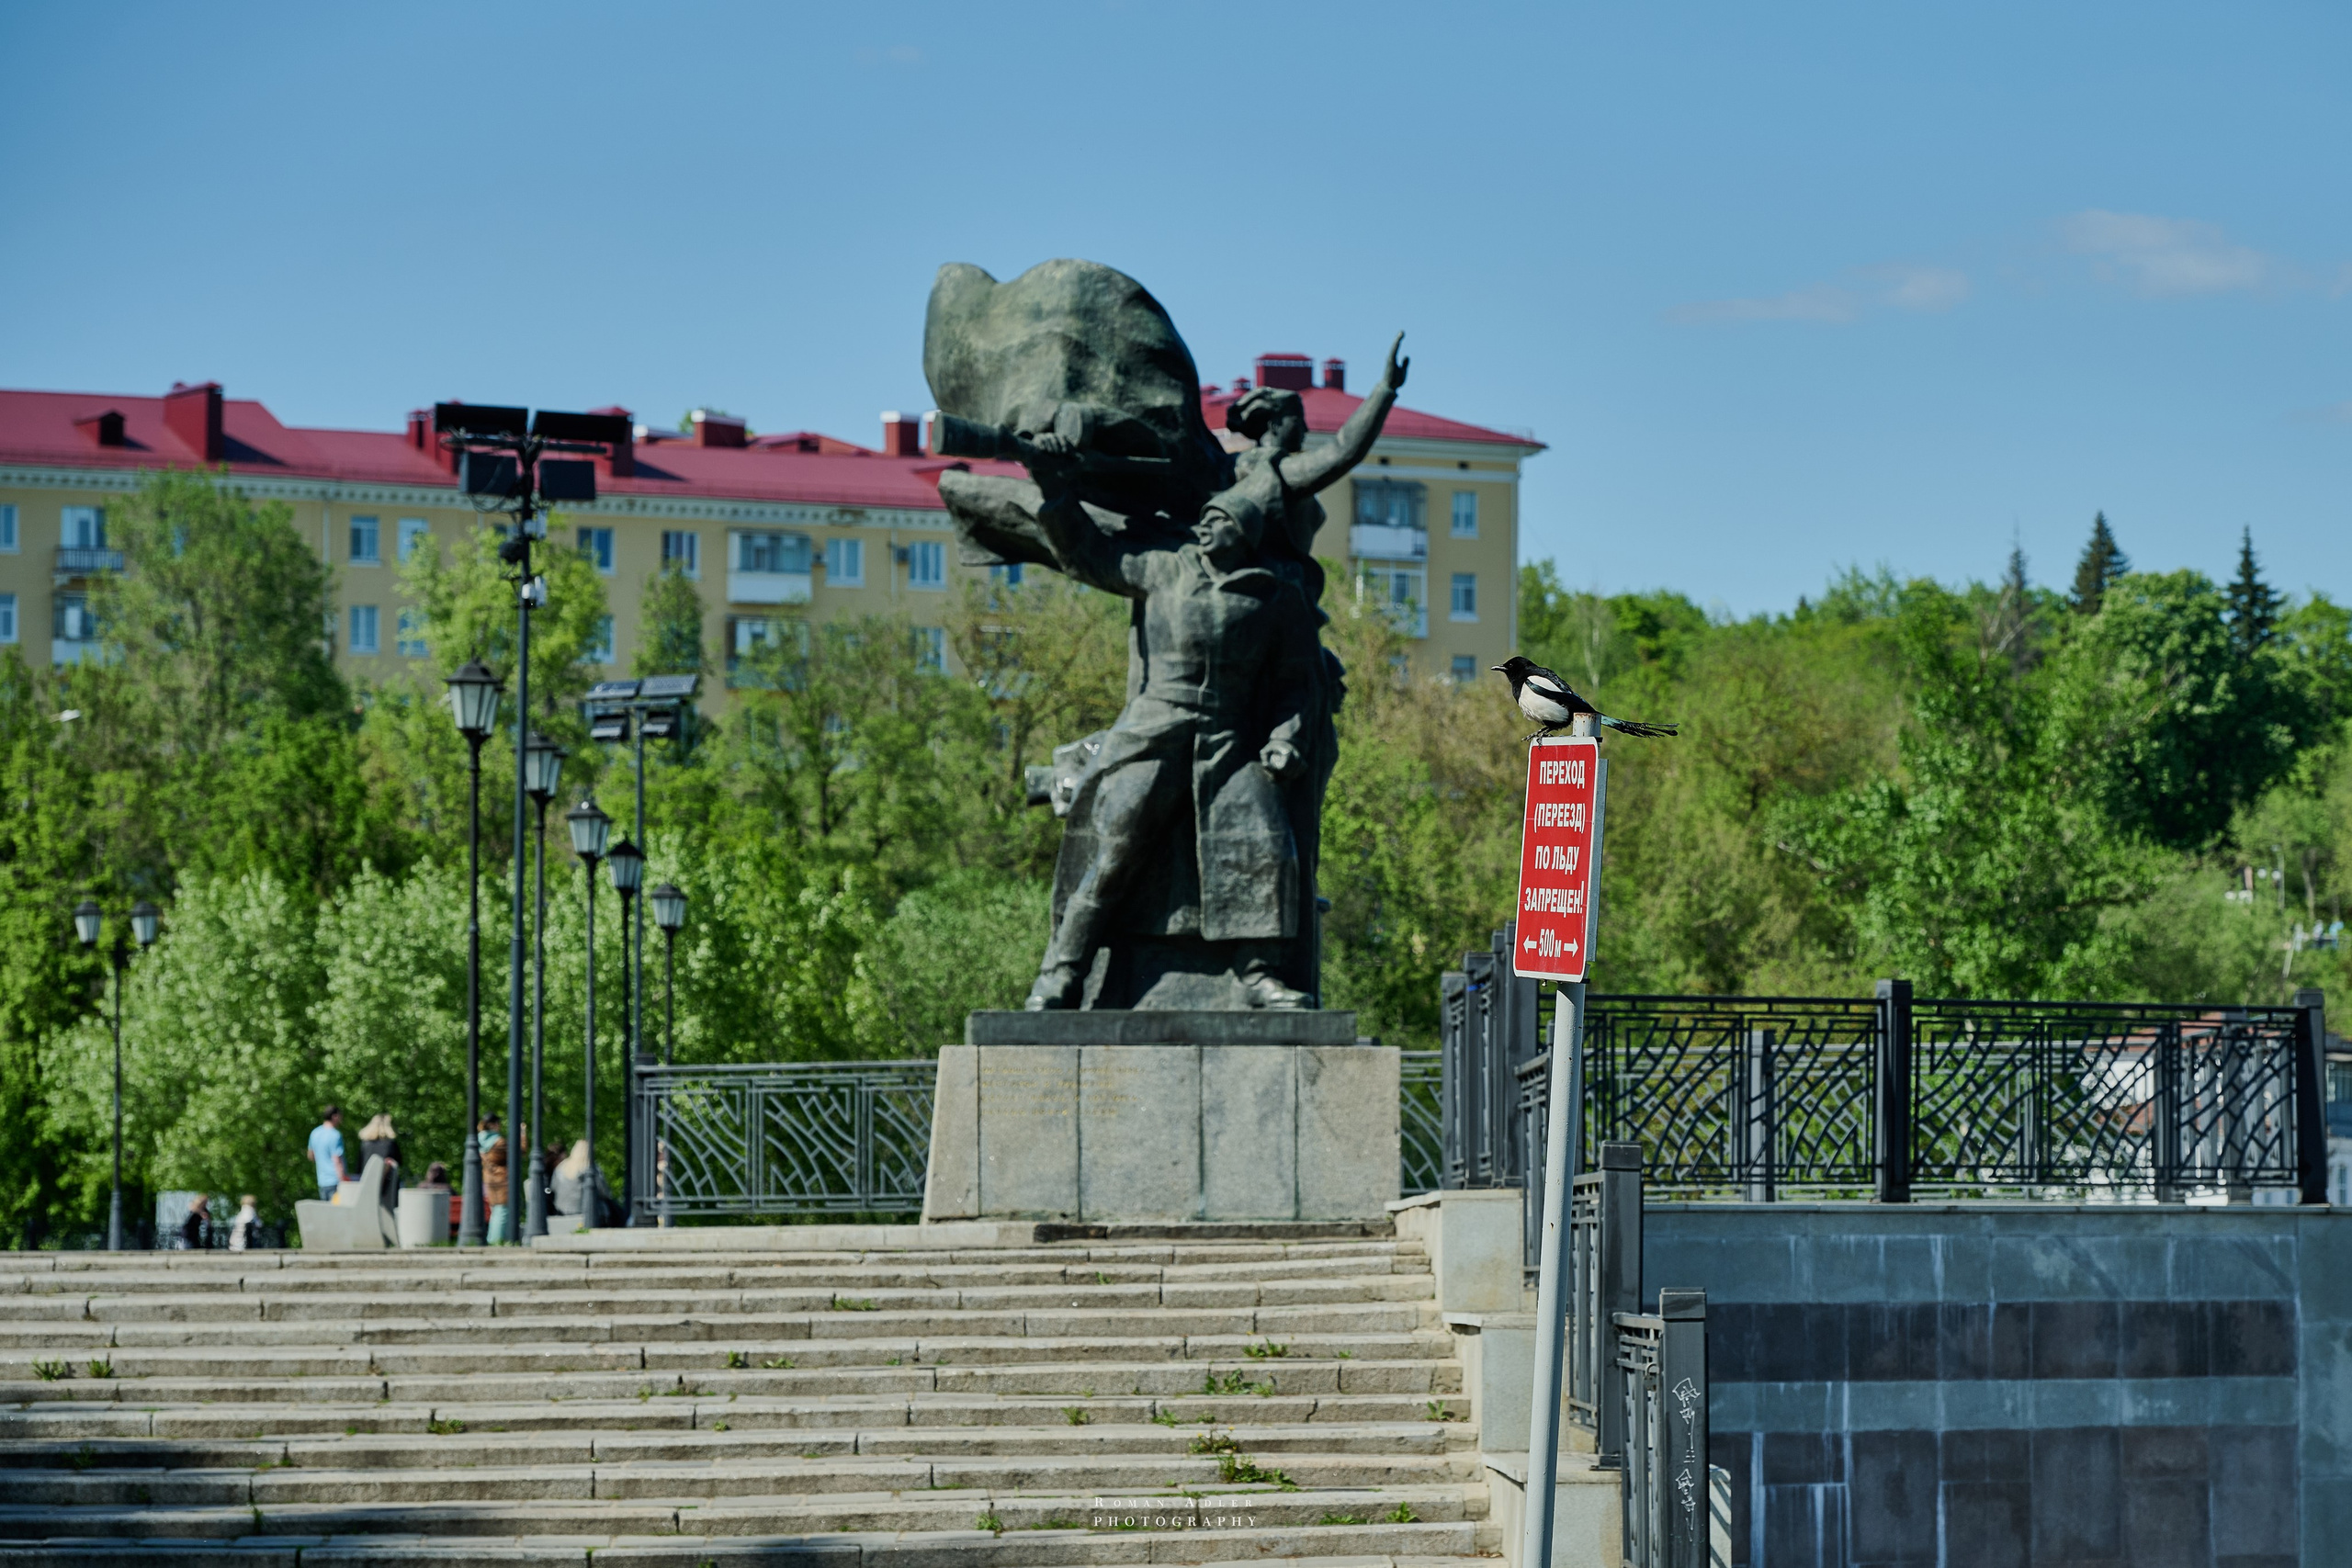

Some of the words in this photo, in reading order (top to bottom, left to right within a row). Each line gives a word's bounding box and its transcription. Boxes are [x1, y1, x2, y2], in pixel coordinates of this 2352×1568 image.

[1539, 760, 1586, 790] ПЕРЕХОД
[1533, 802, 1586, 834] (ПЕРЕЕЗД)
[1534, 845, 1551, 870] ПО
[1551, 845, 1580, 875] ЛЬДУ
[1524, 880, 1585, 919] ЗАПРЕЩЕН!
